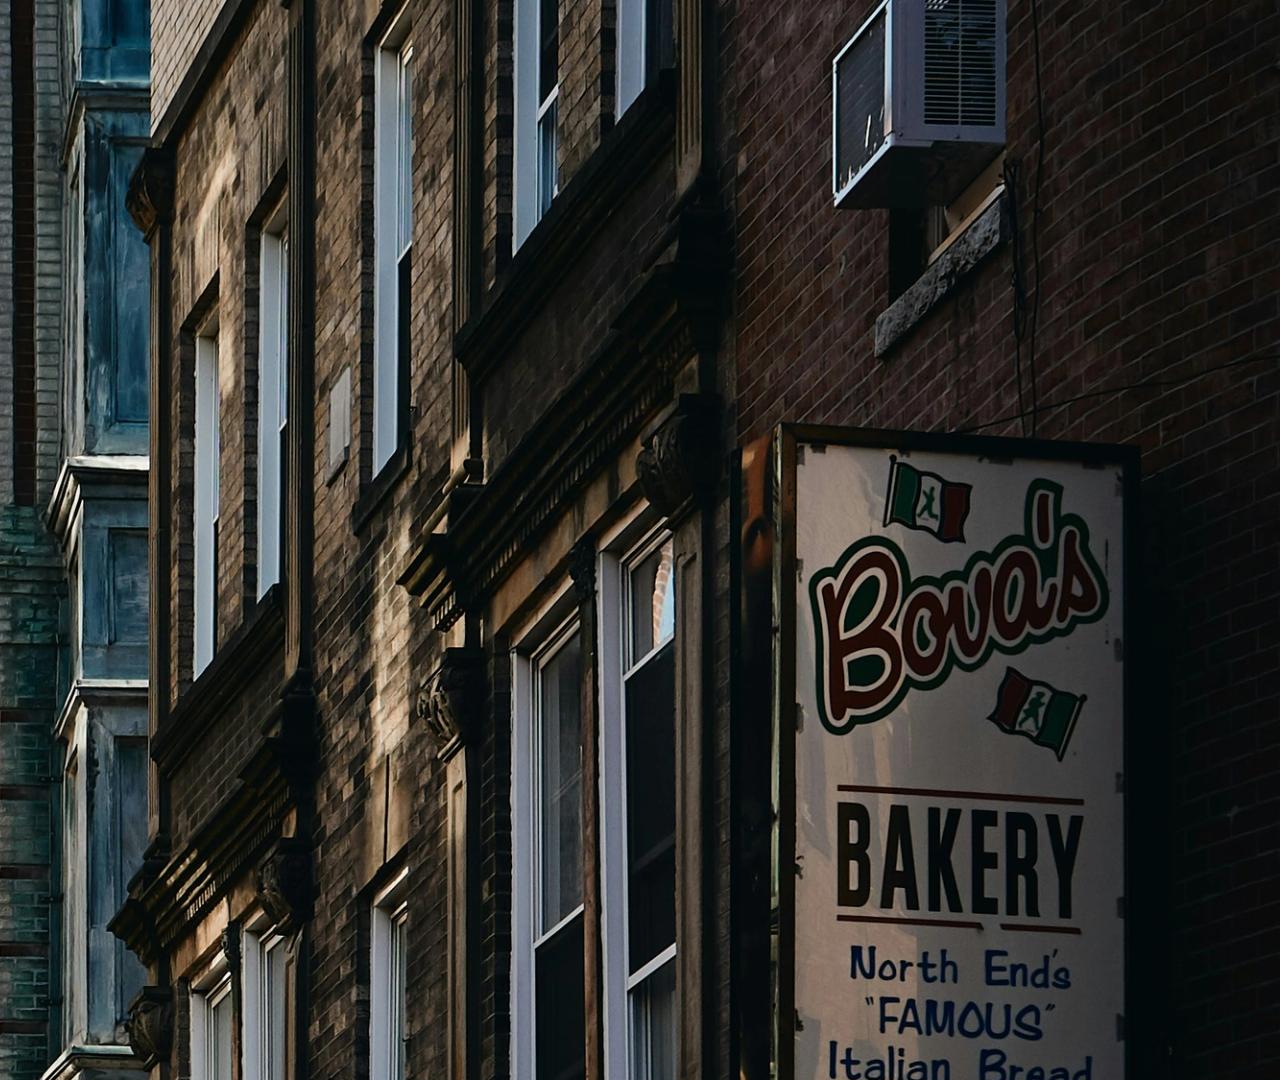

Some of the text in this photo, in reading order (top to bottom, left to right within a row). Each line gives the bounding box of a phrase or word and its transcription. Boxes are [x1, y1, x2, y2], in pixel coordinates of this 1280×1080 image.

[812, 482, 1108, 732] Bova's
[838, 802, 1083, 918] BAKERY
[851, 946, 1071, 988] North End's
